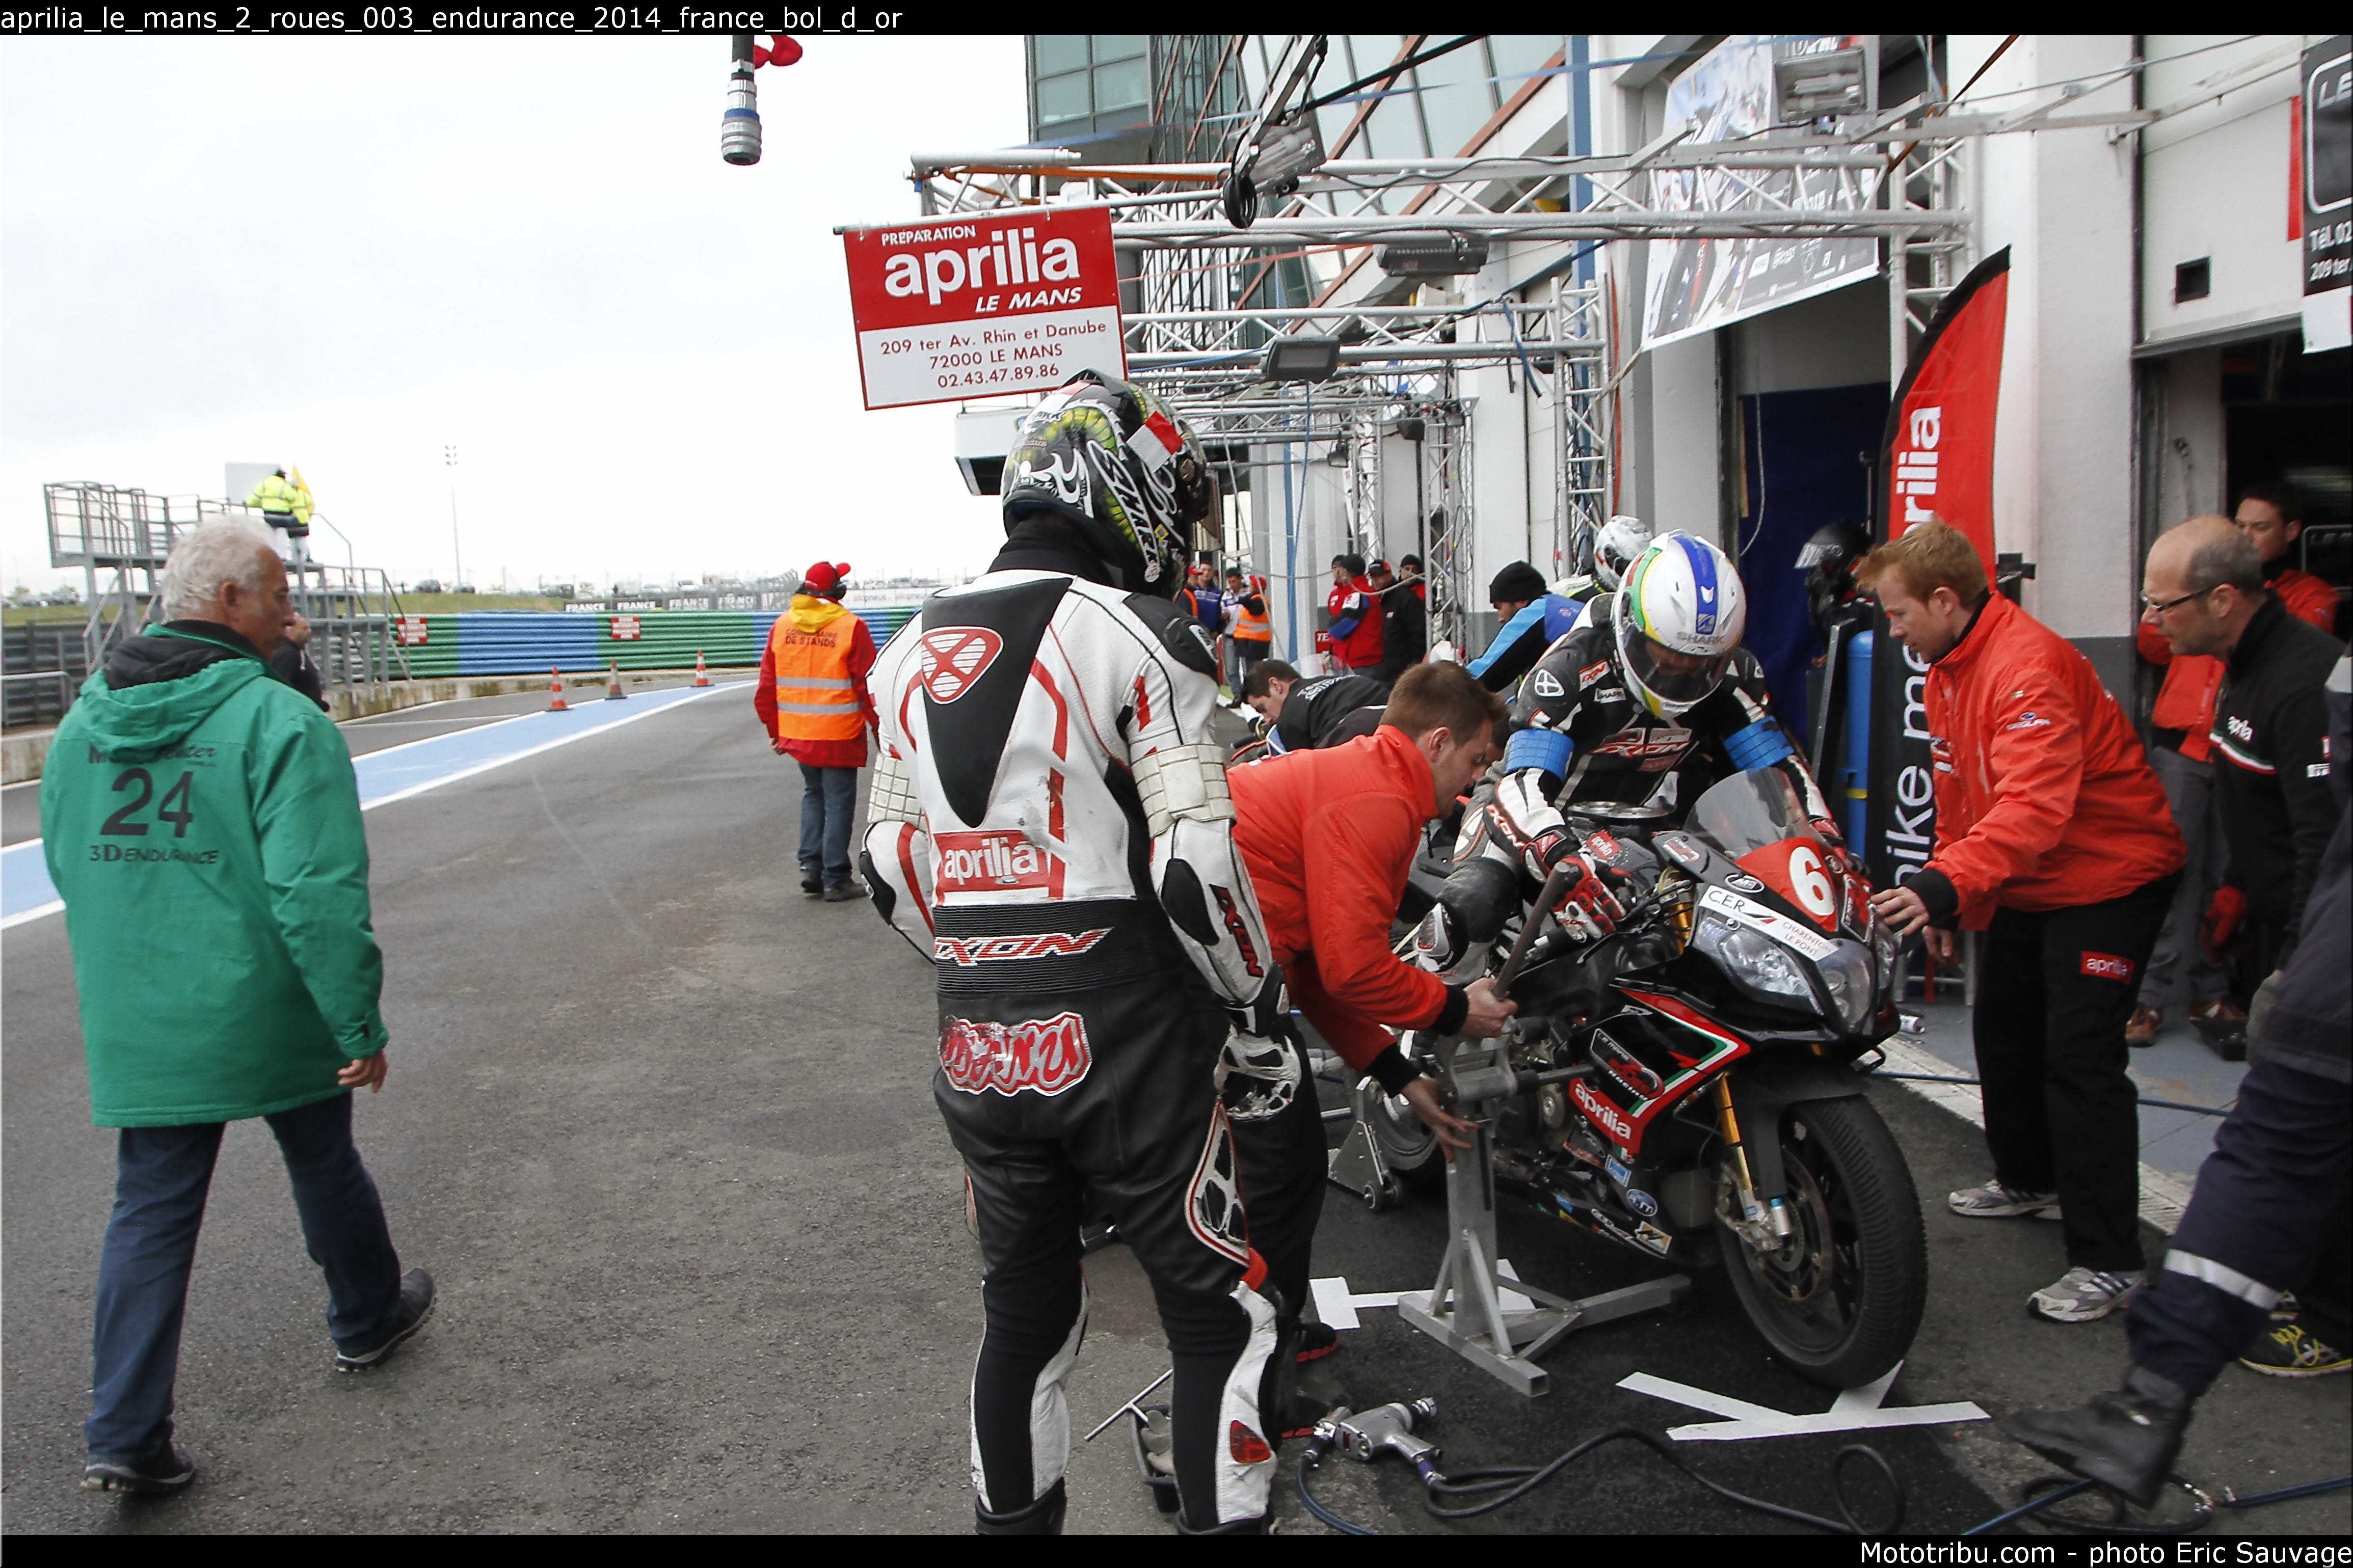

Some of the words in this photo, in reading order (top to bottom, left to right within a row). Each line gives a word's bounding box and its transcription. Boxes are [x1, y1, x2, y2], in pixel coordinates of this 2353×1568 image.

[885, 227, 1081, 306] aprilia
[975, 294, 1000, 314] LE
[1008, 287, 1082, 310] MANS
[880, 340, 912, 355] 209
[919, 338, 942, 352] ter
[949, 334, 976, 348] Av.
[983, 330, 1017, 345] Rhin
[1024, 327, 1038, 340] et
[1046, 320, 1107, 338] Danube
[929, 352, 982, 370] 72000
[990, 349, 1006, 364] LE
[1013, 343, 1063, 360] MANS
[937, 362, 1060, 389] 02.43.47.89.86
[566, 603, 605, 612] FRANCE
[617, 601, 656, 611] FRANCE
[785, 635, 796, 644] DE
[799, 636, 836, 647] STANDS
[1677, 631, 1725, 644] SHARK
[100, 767, 194, 838] 24
[1591, 835, 1613, 858] aprilia
[944, 836, 1040, 885] aprilia
[1789, 846, 1835, 916] 6
[1784, 933, 1796, 943] LE
[1795, 937, 1817, 956] PONT
[1574, 1083, 1632, 1140] aprilia
